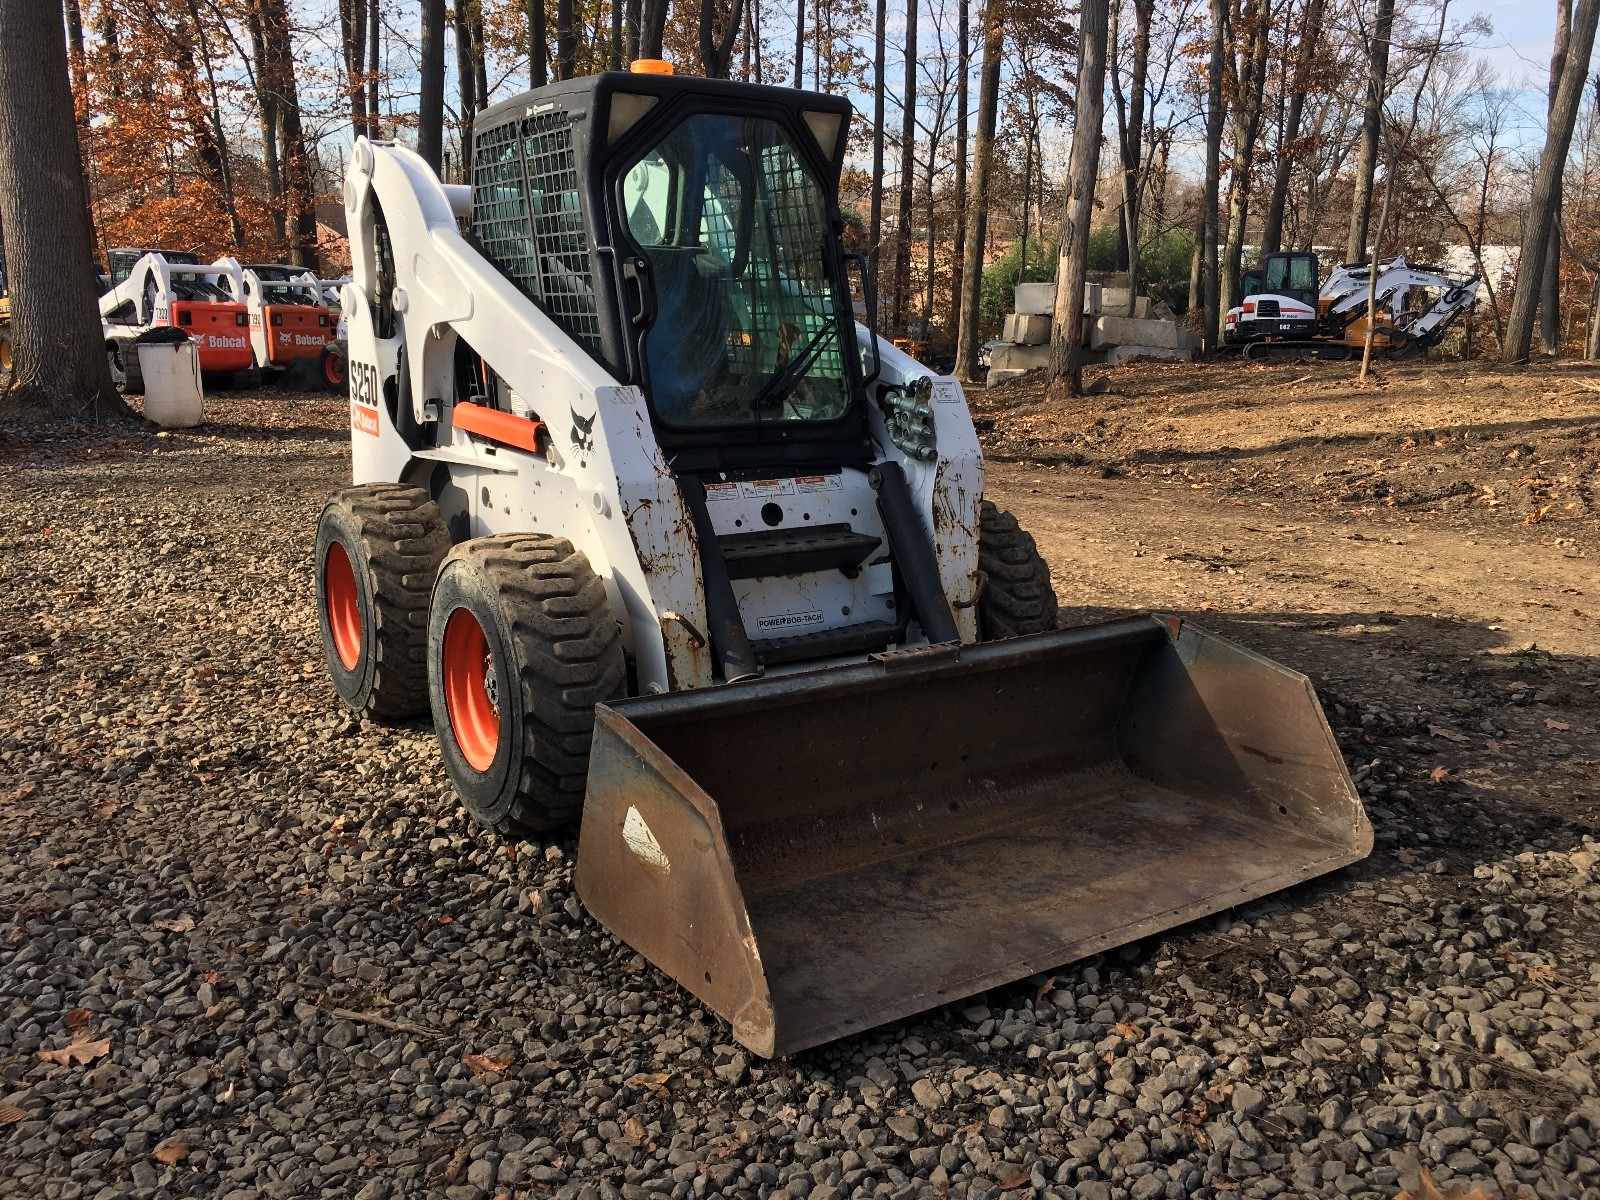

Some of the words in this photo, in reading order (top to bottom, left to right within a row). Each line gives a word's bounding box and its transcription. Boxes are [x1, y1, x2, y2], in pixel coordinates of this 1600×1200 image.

[209, 335, 247, 348] Bobcat
[295, 334, 326, 346] Bobcat
[351, 360, 378, 407] S250
[759, 618, 786, 628] POWER
[786, 613, 822, 624] BOB-TACH
